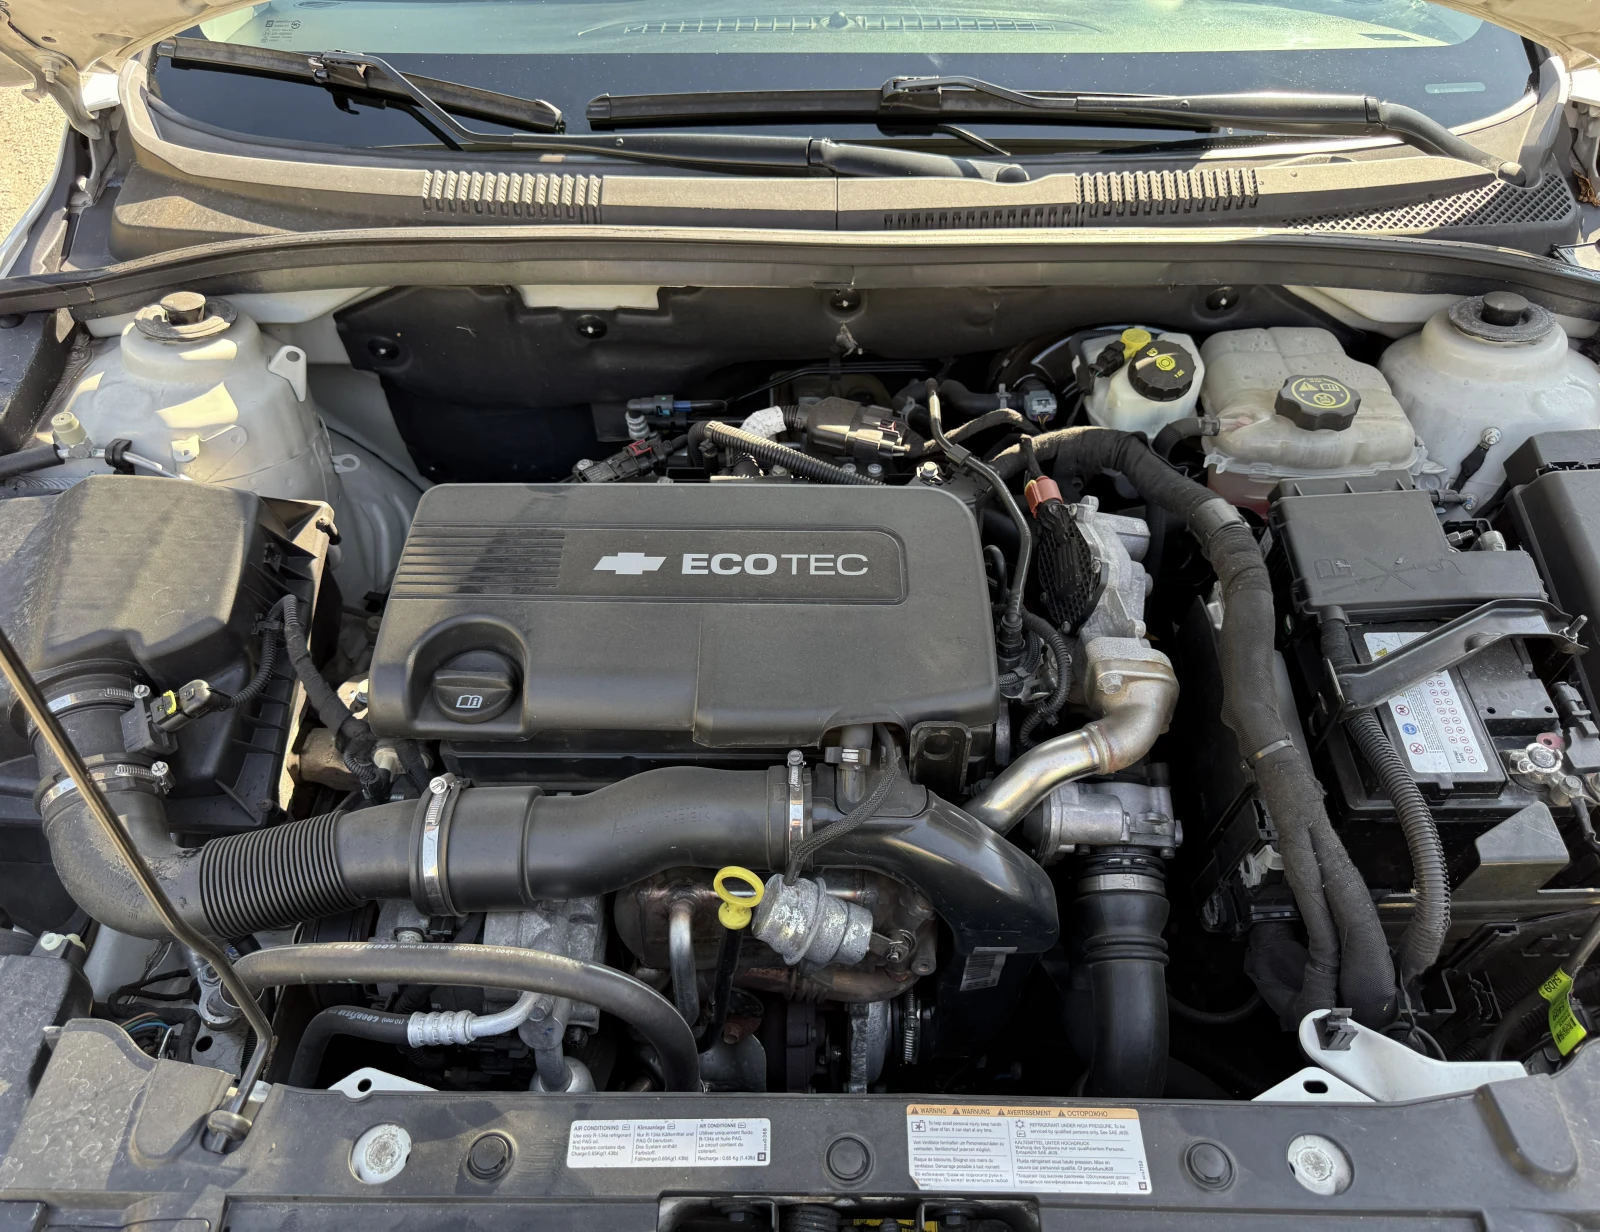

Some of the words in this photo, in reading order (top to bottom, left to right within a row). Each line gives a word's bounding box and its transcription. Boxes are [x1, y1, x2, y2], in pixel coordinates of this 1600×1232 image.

[682, 554, 868, 576] ECOTEC
[1544, 974, 1562, 993] 5409
[337, 1010, 379, 1022] GOODYEAR
